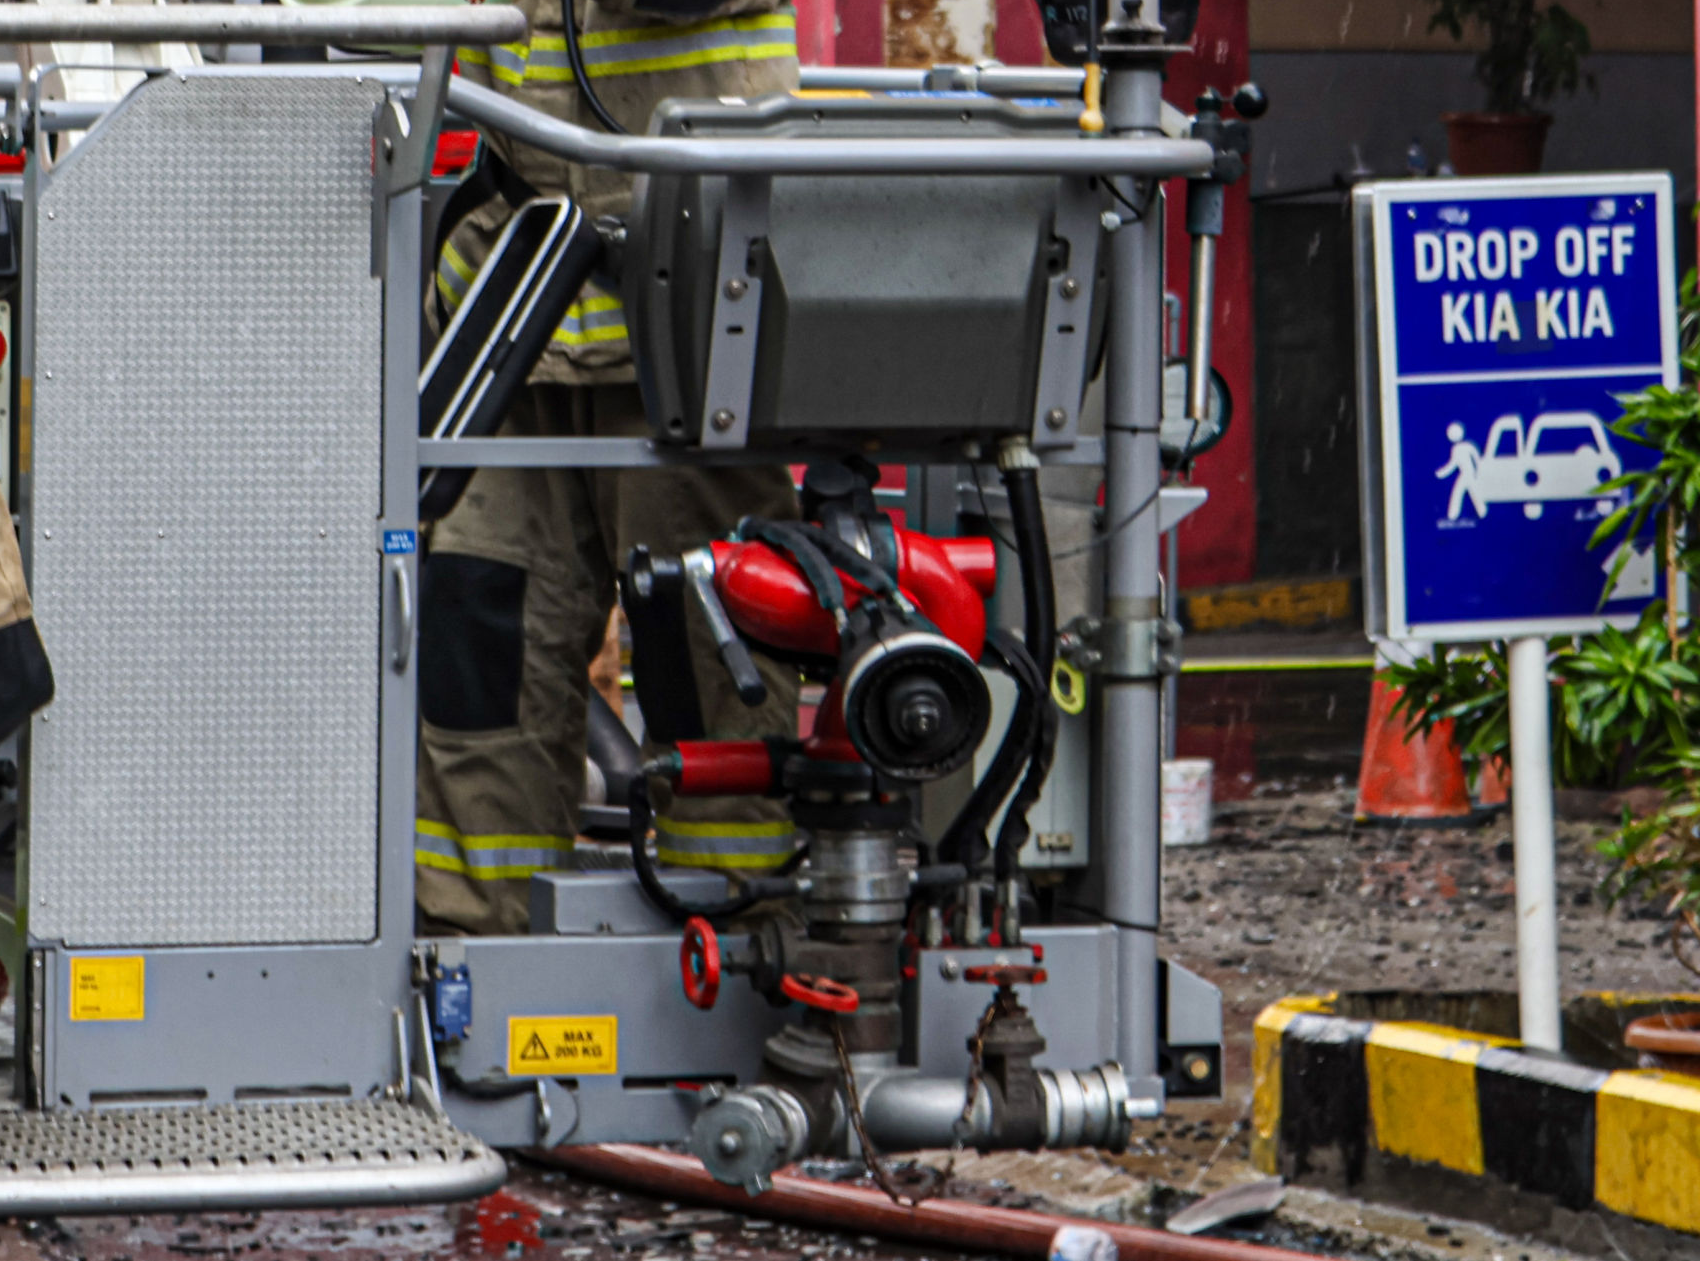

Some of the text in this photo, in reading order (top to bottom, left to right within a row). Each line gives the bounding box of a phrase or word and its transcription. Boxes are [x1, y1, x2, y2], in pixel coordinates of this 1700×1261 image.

[1413, 224, 1636, 283] DROP OFF
[1442, 286, 1615, 344] KIA KIA
[564, 1031, 594, 1041] MAX
